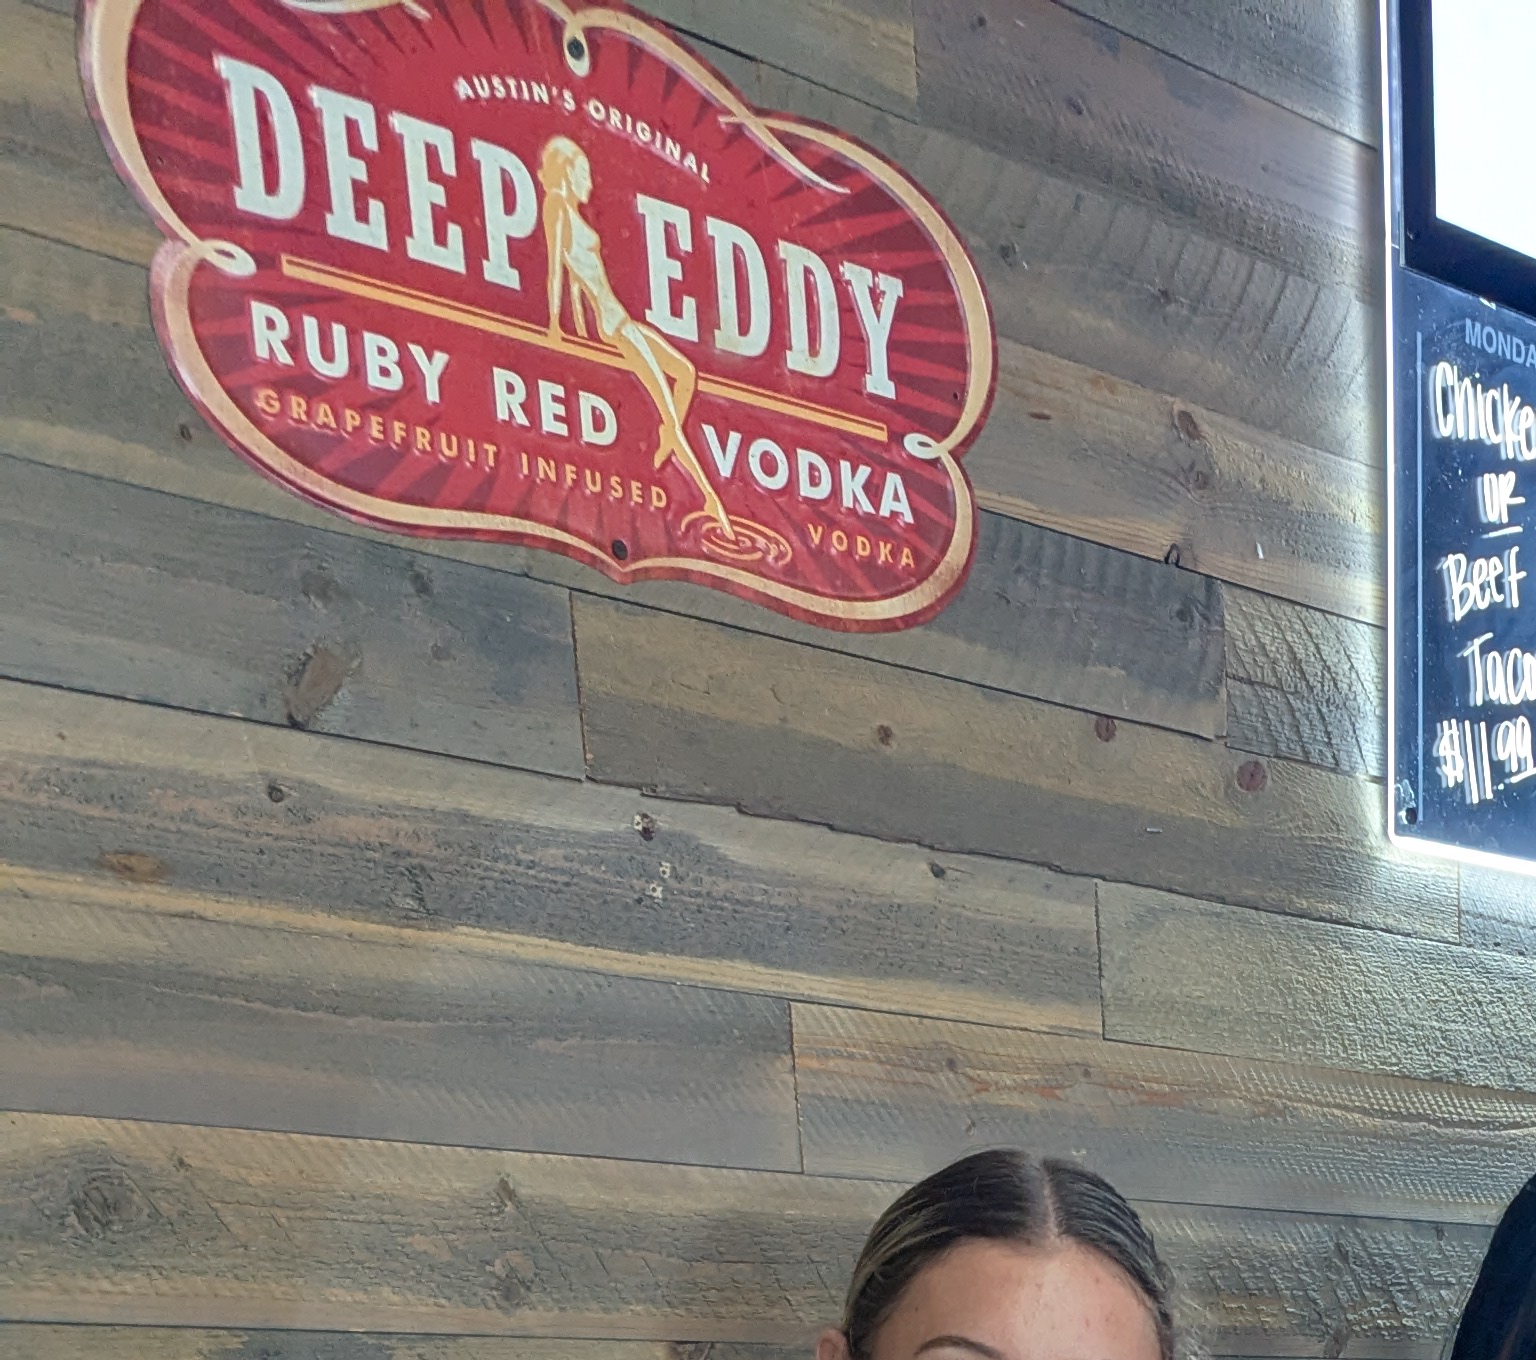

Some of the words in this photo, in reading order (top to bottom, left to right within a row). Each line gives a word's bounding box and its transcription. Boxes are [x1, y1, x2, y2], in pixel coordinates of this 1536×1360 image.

[455, 73, 577, 113] AUSTIN'S
[587, 97, 711, 184] ORIGINAL
[214, 52, 541, 291] DEEP
[636, 191, 905, 400] EDDY
[249, 300, 450, 405] RUBY
[493, 367, 619, 447] RED
[701, 422, 917, 525] VODKA
[256, 386, 499, 470] GRAPEFRUIT
[521, 450, 669, 512] INFUSED
[808, 522, 917, 569] VODKA
[1440, 546, 1527, 621] Beef
